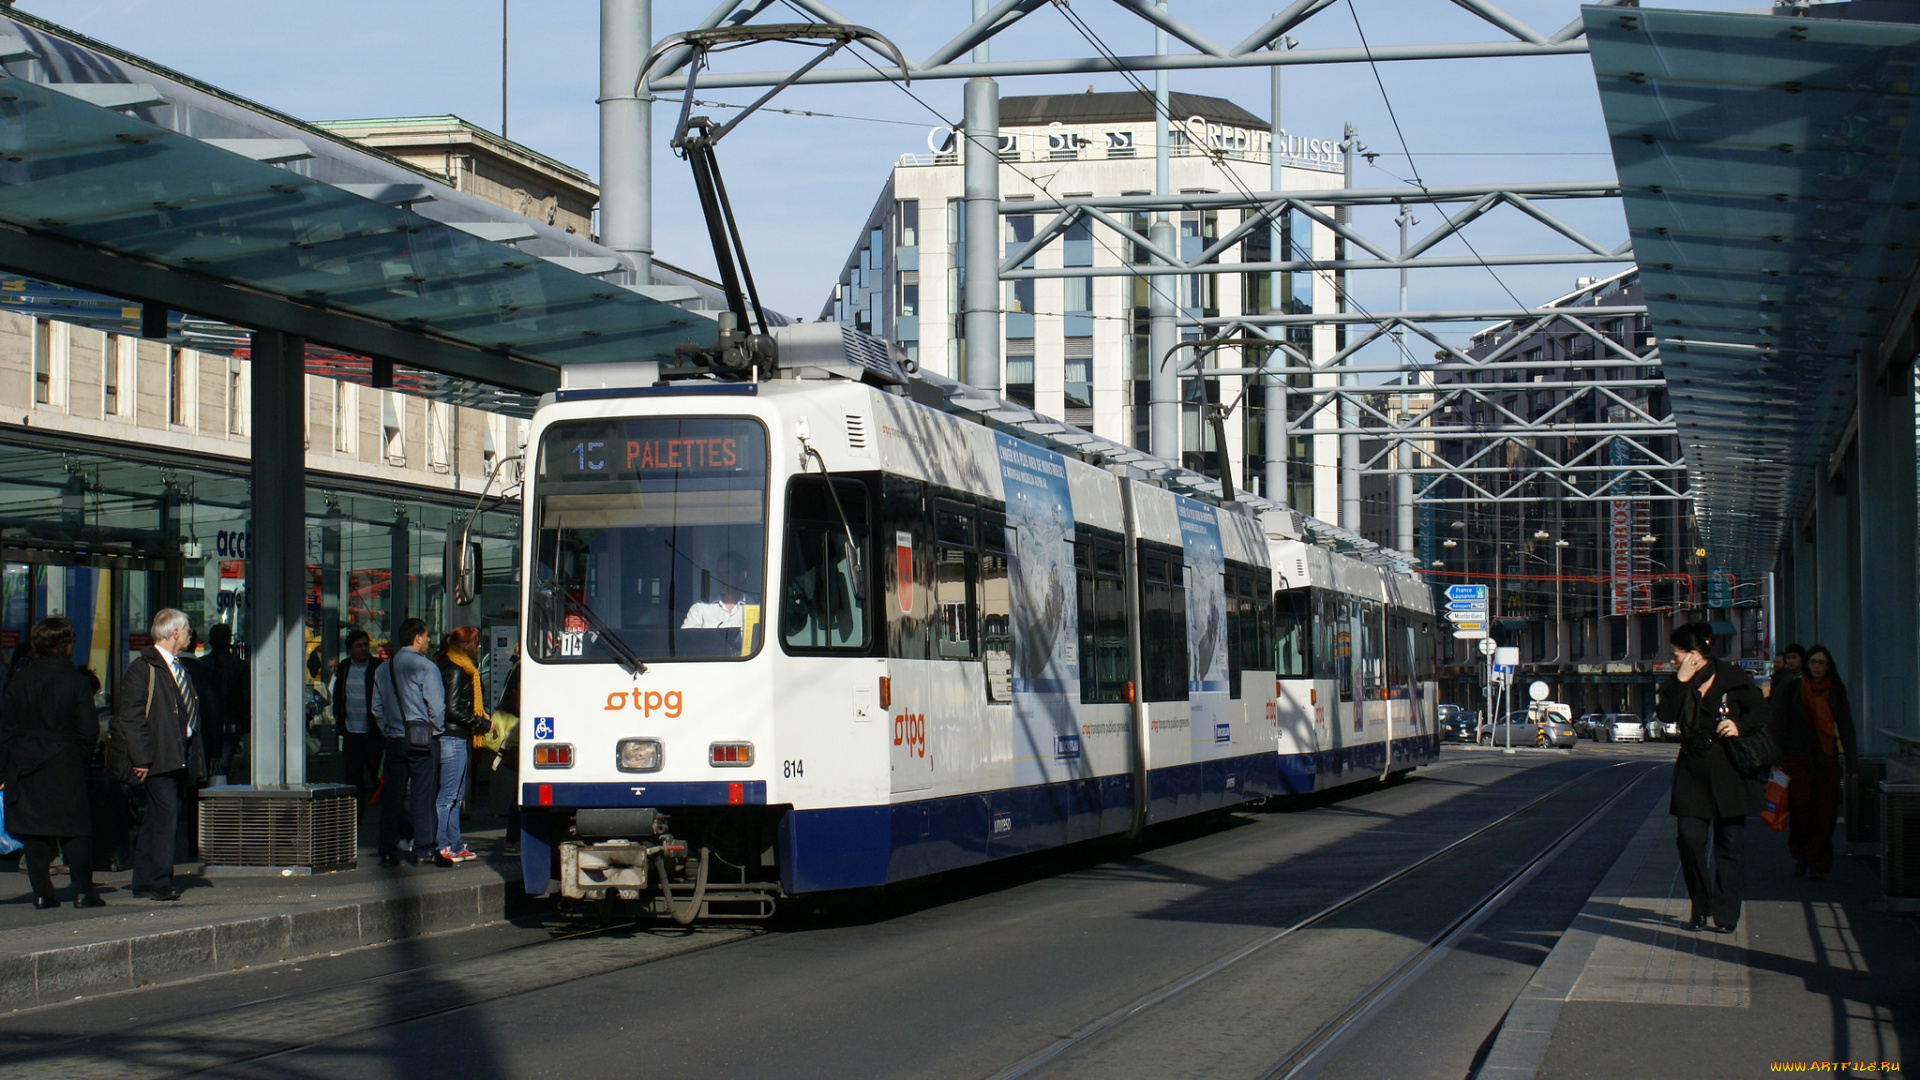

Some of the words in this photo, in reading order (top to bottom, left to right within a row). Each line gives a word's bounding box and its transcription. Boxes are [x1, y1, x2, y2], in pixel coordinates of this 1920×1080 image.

[1185, 115, 1271, 152] CREDIT
[626, 438, 737, 469] PALETTES
[1695, 548, 1706, 557] 40
[564, 638, 581, 651] 14
[783, 759, 804, 778] 814
